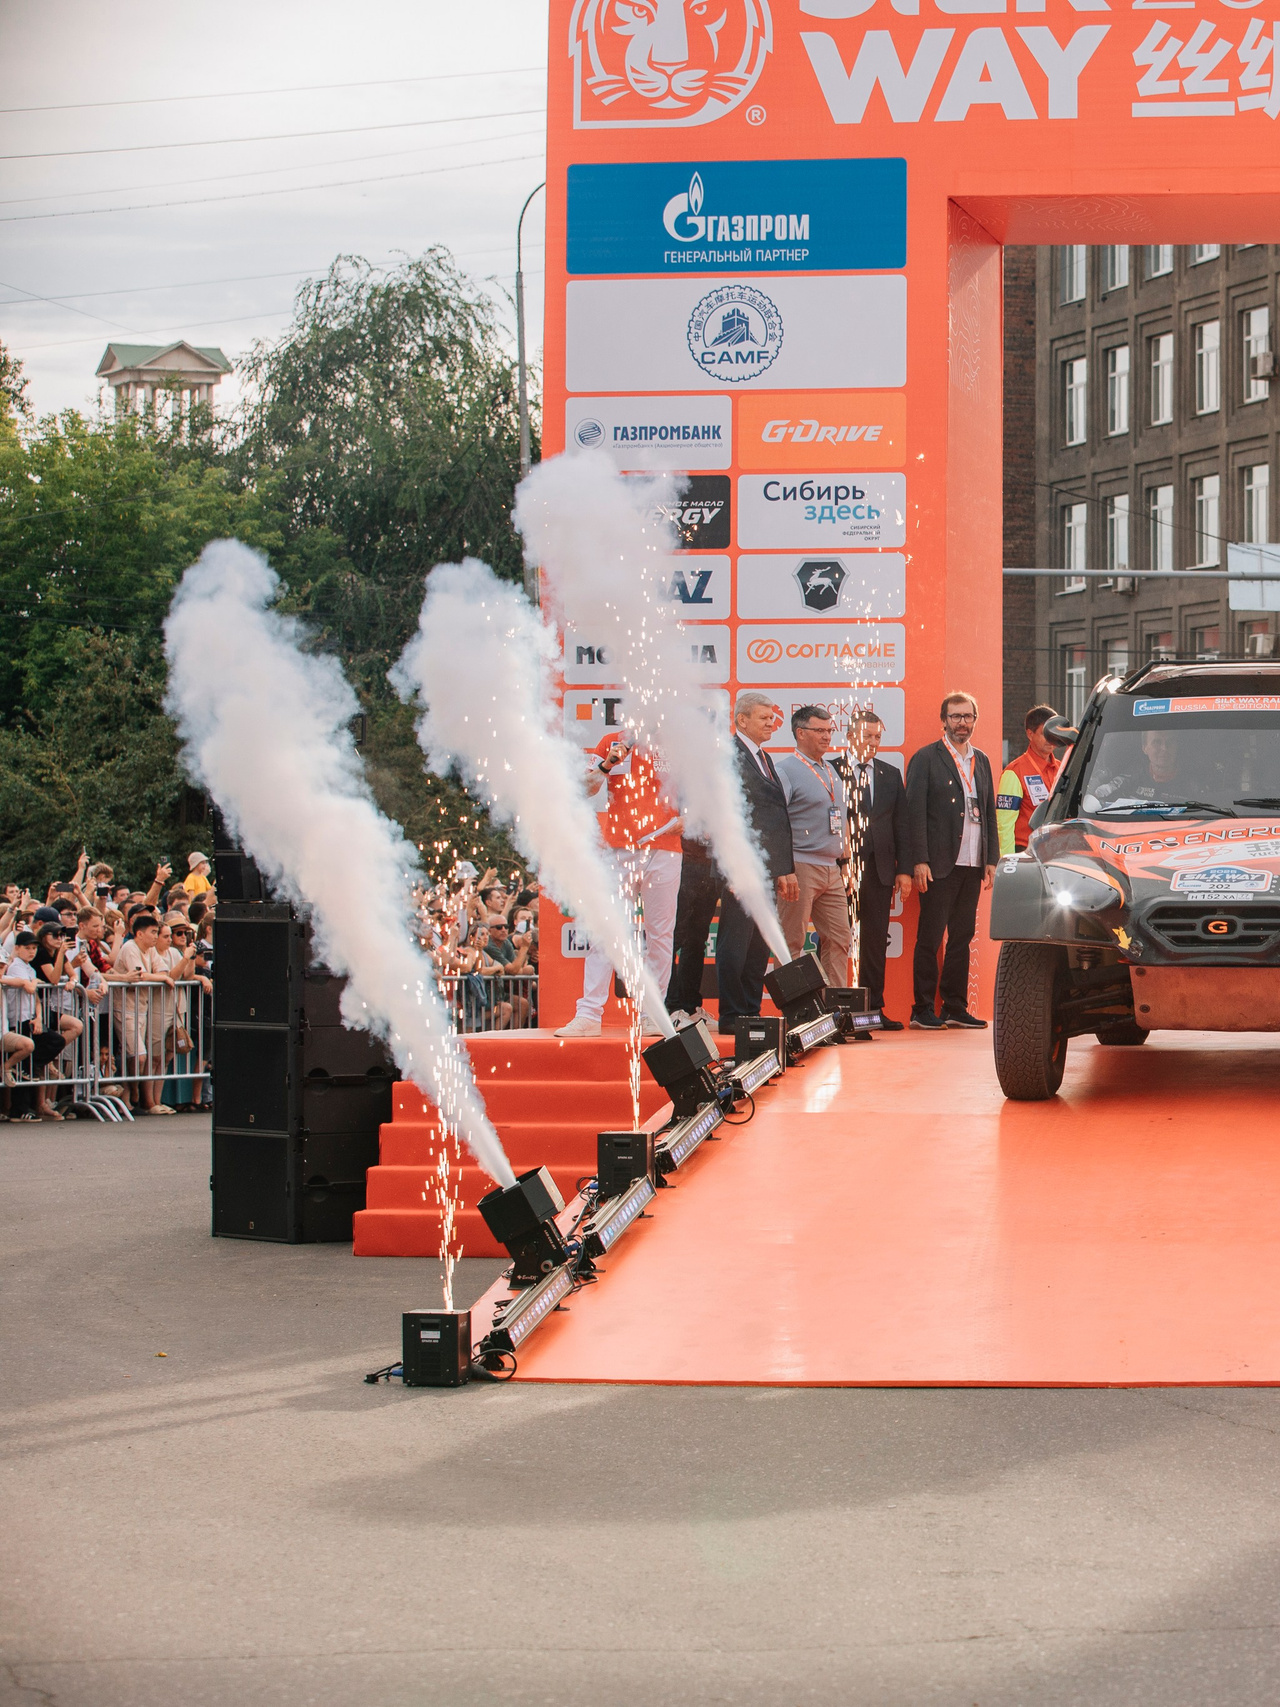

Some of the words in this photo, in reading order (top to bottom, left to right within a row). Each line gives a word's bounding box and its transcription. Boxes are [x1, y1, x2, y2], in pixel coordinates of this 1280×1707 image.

[799, 25, 1111, 125] WAY
[707, 214, 810, 242] ГАЗПРОМ
[664, 248, 752, 264] ГЕНЕРАЛЬНЫЙ
[755, 248, 810, 262] ПАРТНЕР
[701, 350, 770, 365] CAMF
[613, 425, 722, 441] ГАЗПРОМБАНК
[763, 480, 866, 506] Сибирь
[804, 504, 881, 524] здесь
[785, 643, 896, 658] СОГЛАСИЕ
[1174, 703, 1208, 711] RUSSIA
[998, 795, 1014, 803] SILK
[998, 801, 1013, 809] WAY
[1100, 840, 1144, 856] NG
